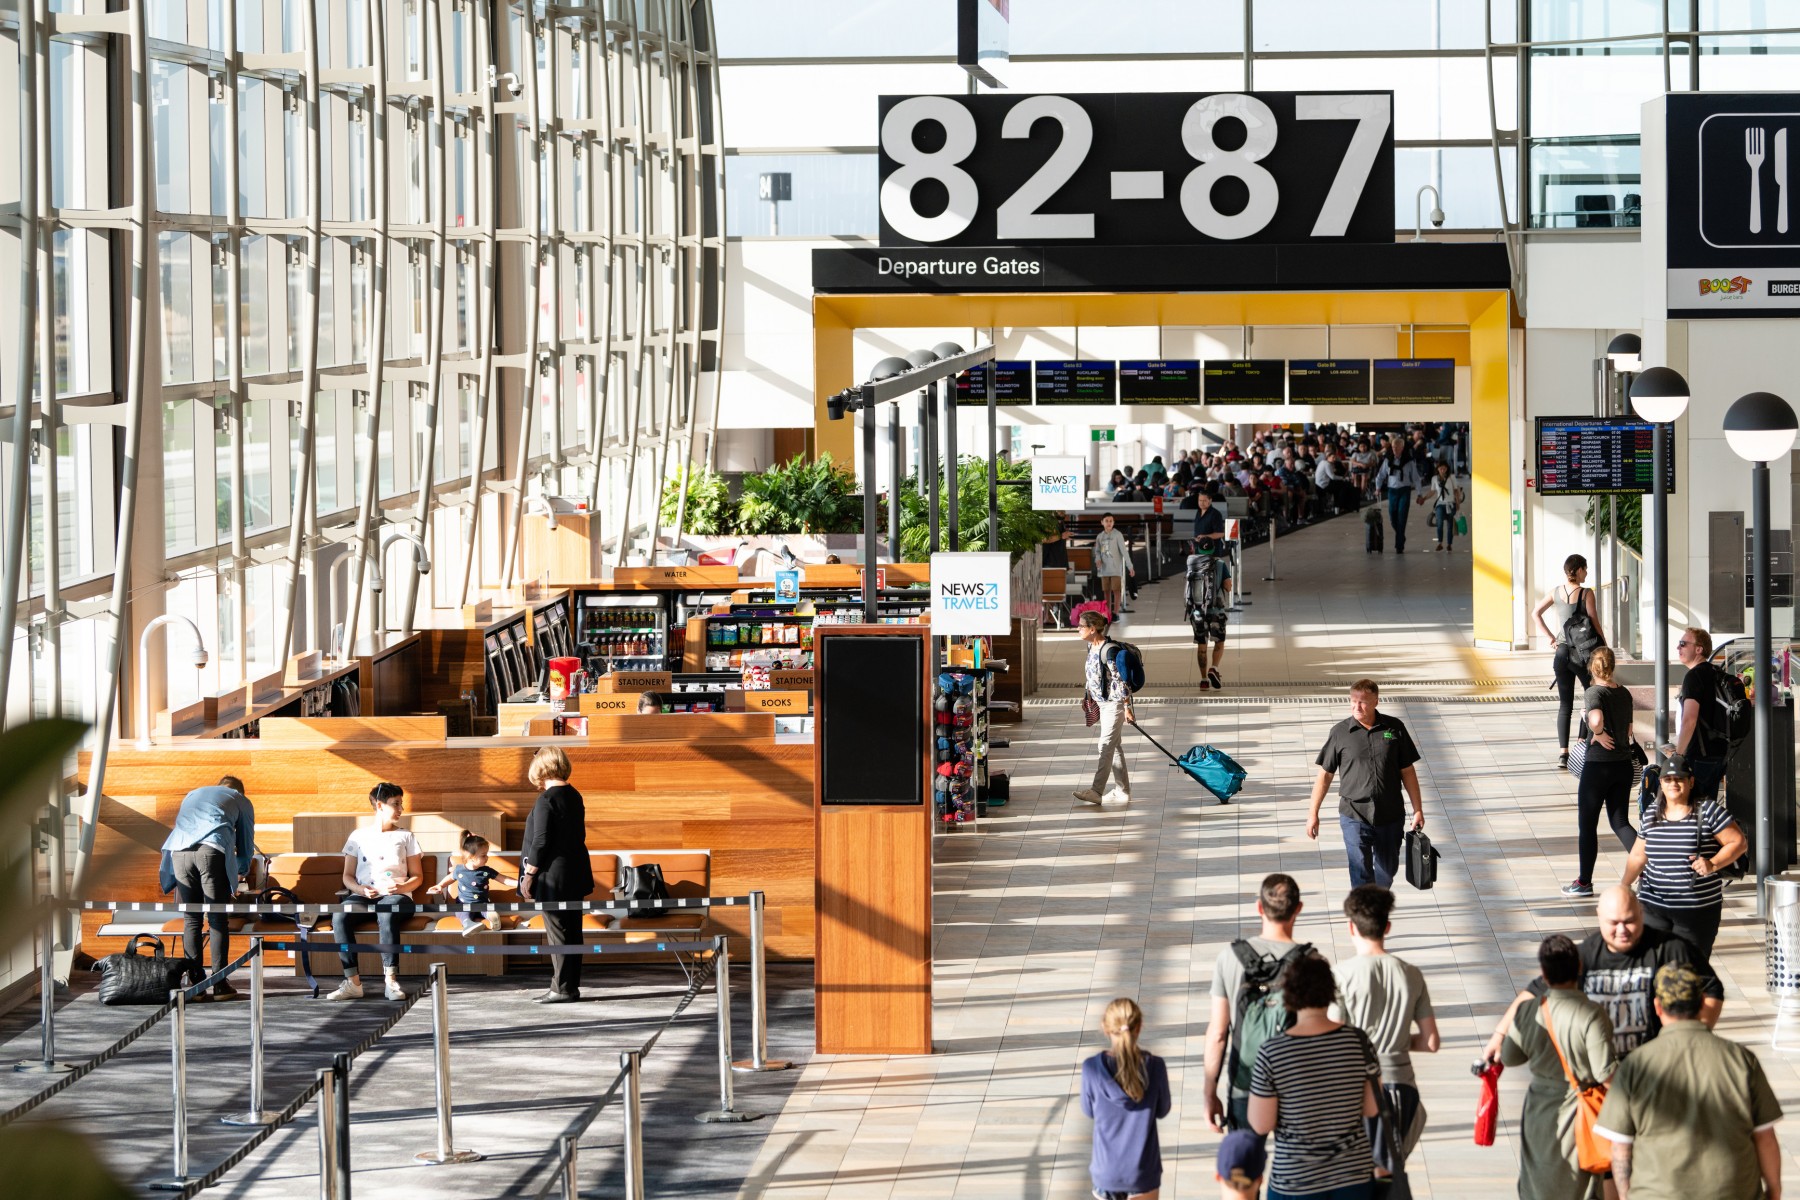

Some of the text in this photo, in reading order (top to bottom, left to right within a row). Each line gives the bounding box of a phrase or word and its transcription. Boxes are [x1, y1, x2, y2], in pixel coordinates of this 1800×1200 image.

[880, 93, 1391, 242] 82-87
[878, 256, 1040, 277] Departure Gates
[1698, 276, 1752, 296] BOOST
[1772, 284, 1800, 293] BURGE
[1039, 476, 1067, 484] NEWS
[1040, 485, 1077, 494] TRAVELS
[942, 583, 984, 596] NEWS
[942, 597, 998, 610] TRAVELS
